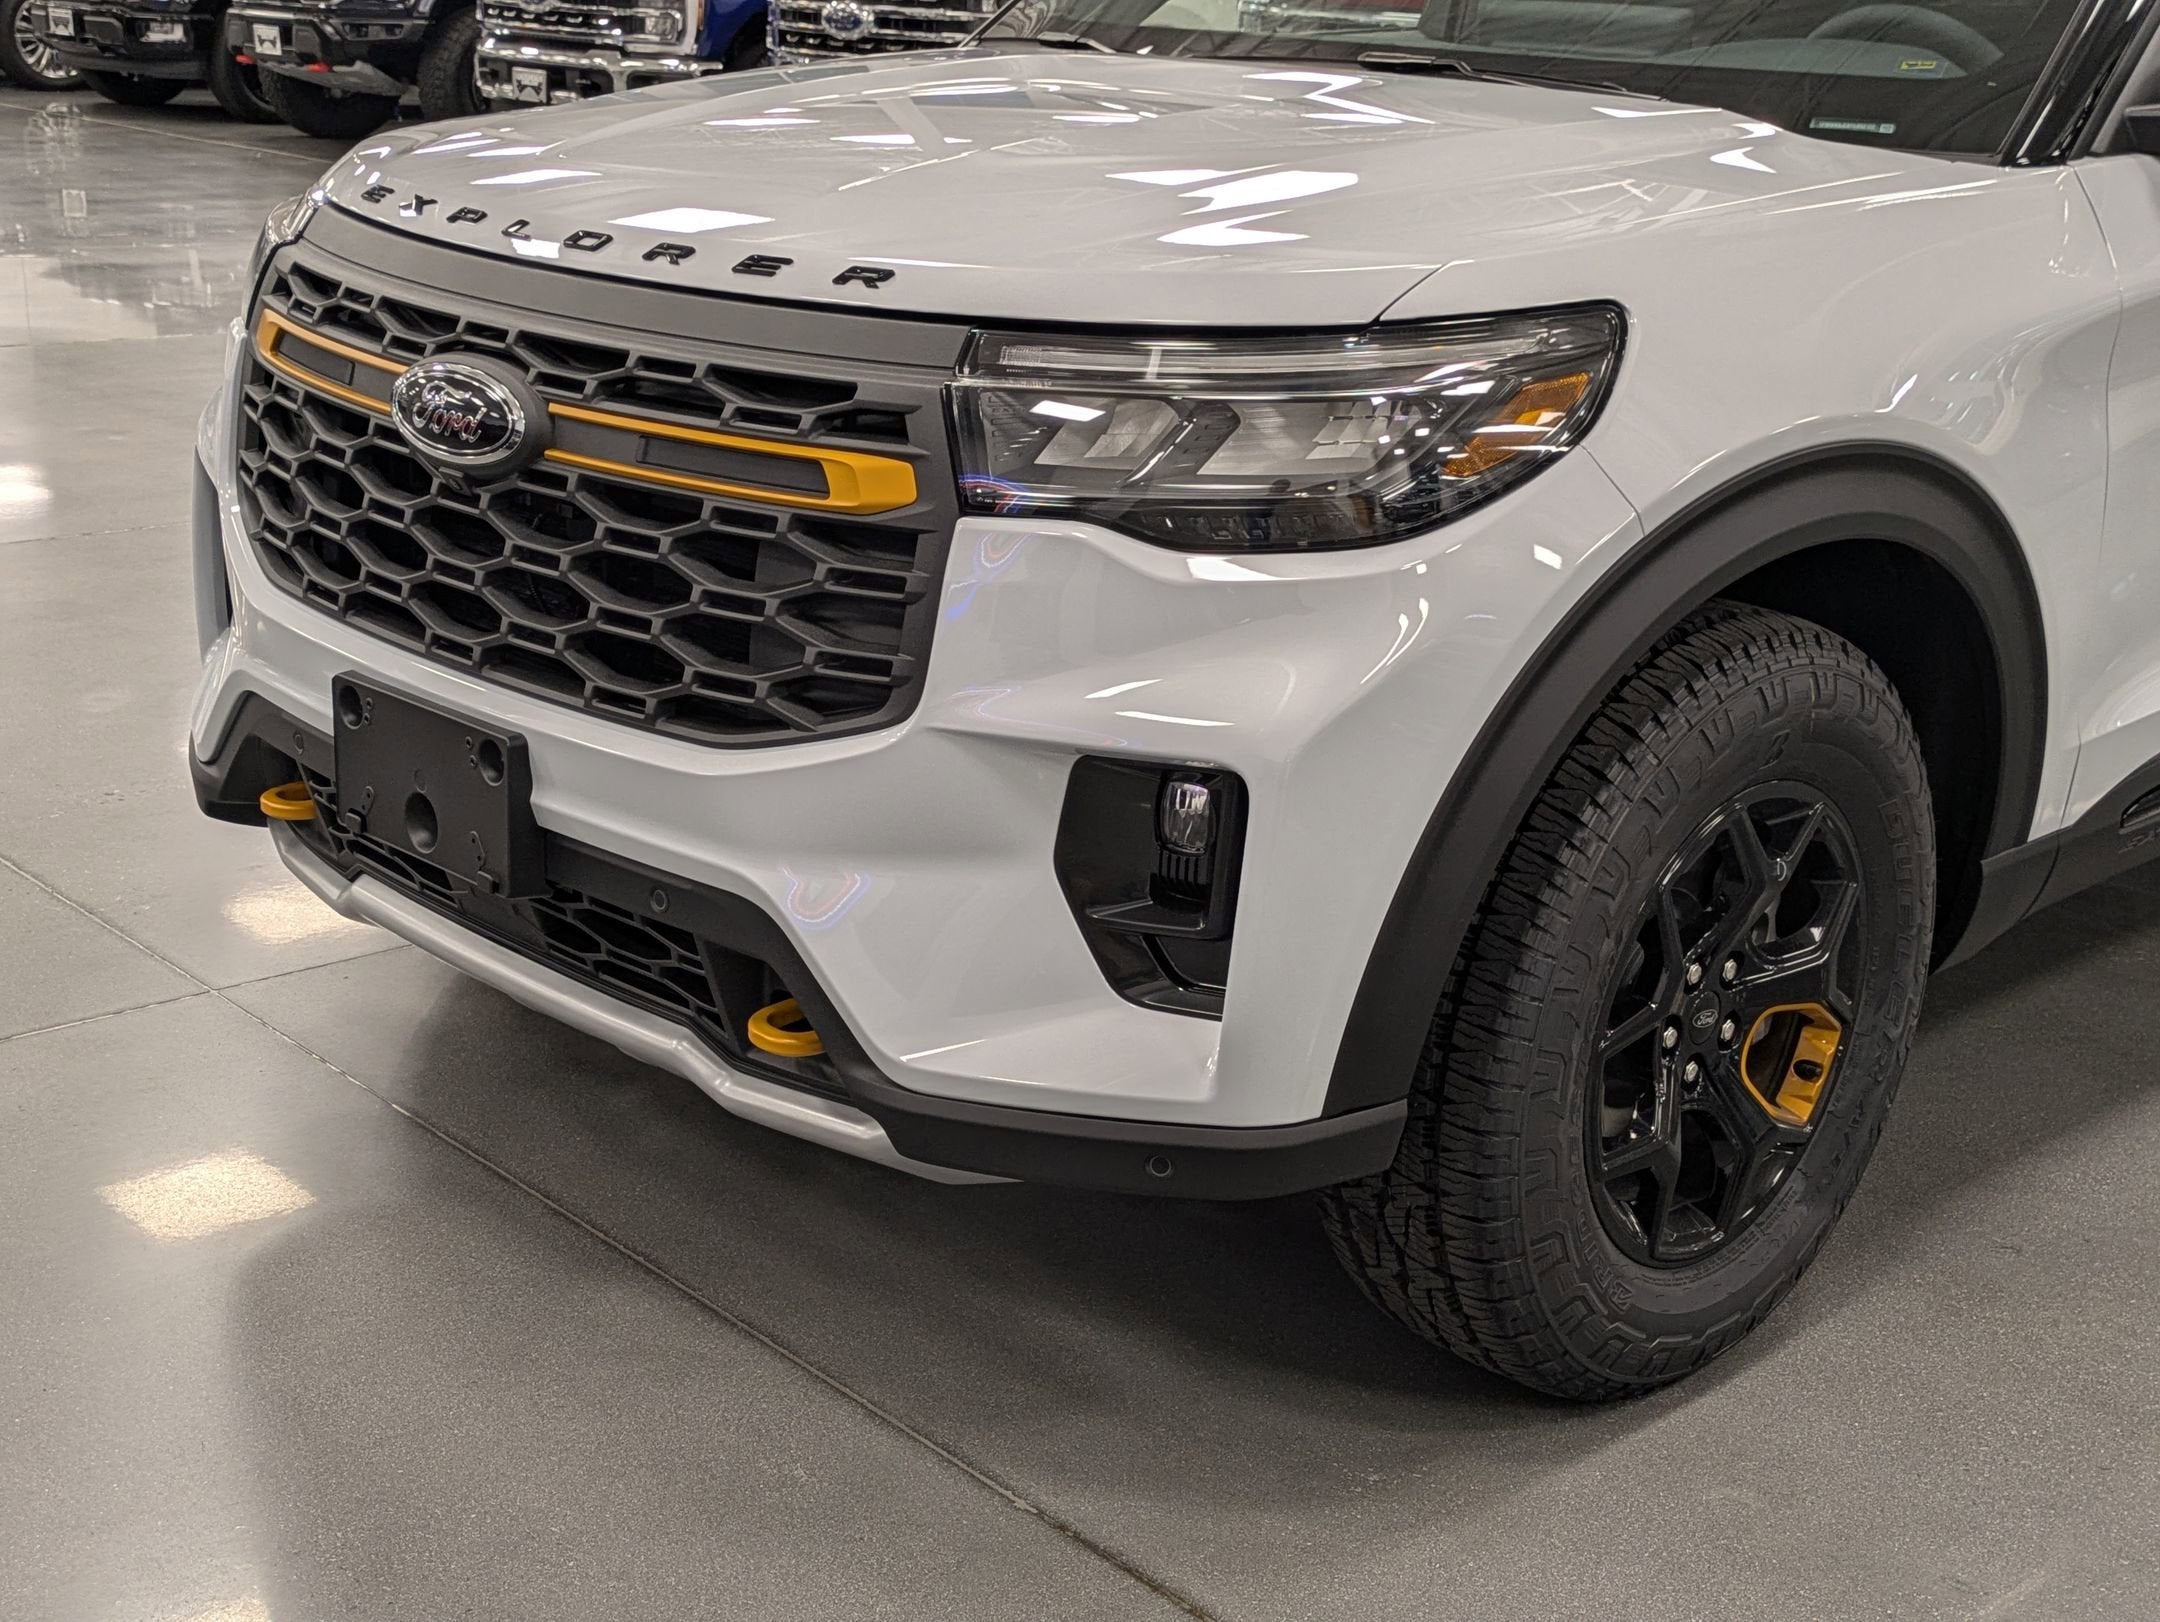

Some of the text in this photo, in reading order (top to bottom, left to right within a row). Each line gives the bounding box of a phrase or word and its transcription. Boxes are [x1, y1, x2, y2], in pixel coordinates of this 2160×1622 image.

[360, 184, 896, 289] EXPLORER
[411, 380, 487, 443] Ford
[1695, 1011, 1717, 1026] Ford
